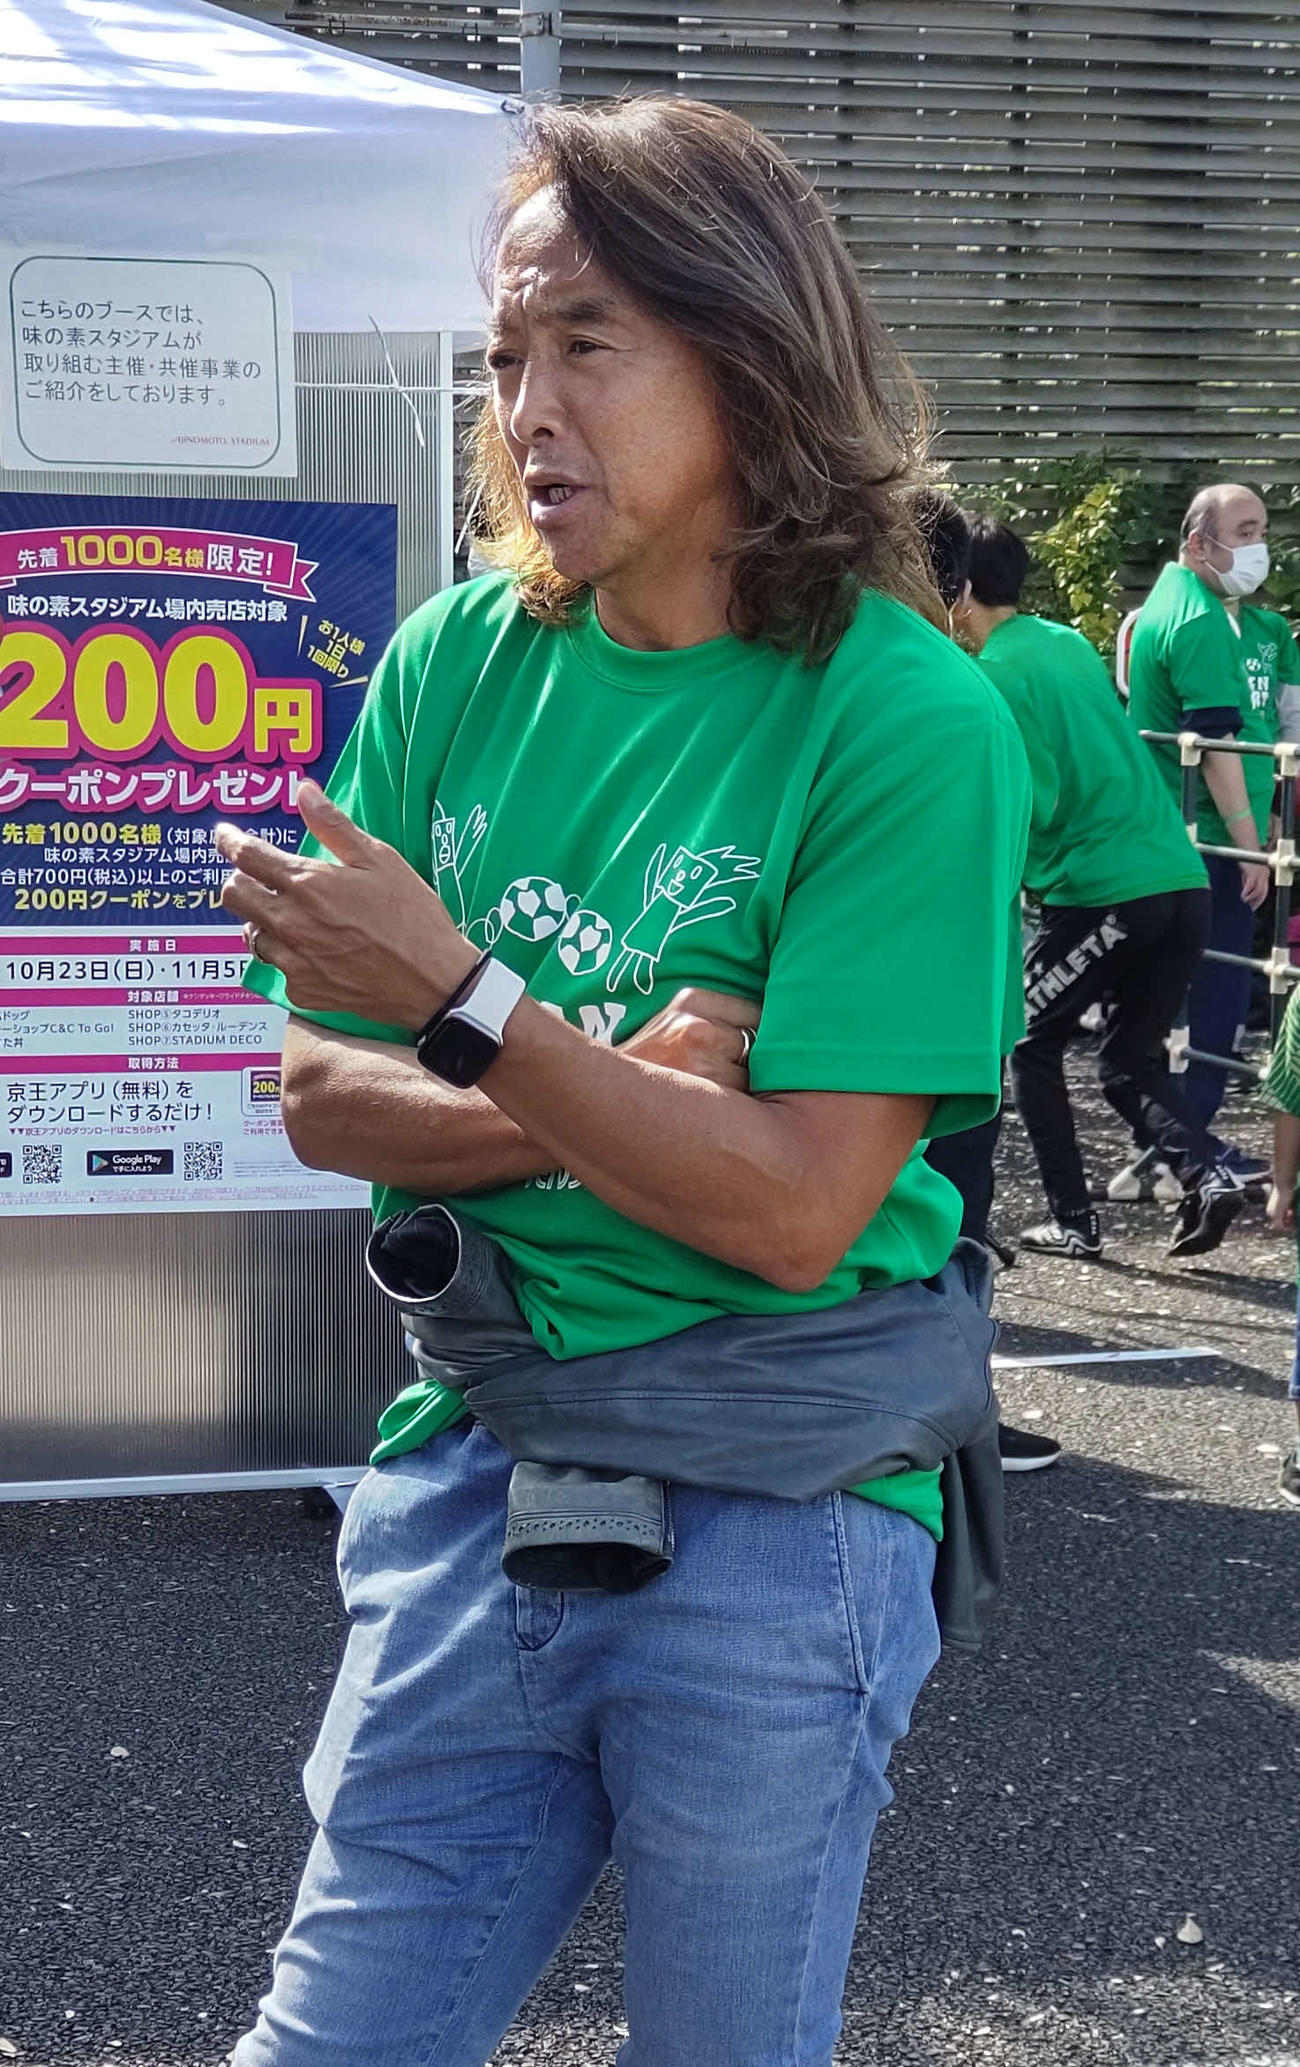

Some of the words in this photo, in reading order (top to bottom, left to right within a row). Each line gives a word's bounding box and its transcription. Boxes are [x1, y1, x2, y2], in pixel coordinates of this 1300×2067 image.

[21, 299, 203, 325] こちらのブースでは、
[22, 326, 202, 351] 味の素スタジアムが
[24, 353, 262, 380] 取り組む主催・共催事業の
[25, 380, 226, 407] ご紹介をしております。
[7, 595, 288, 623] 味の素スタジアム場内売店対象
[307, 644, 349, 678] 1回限り
[44, 847, 233, 864] 味の素スタジアム場内売
[127, 990, 179, 1003] 対象店舗
[0, 1010, 30, 1021] ドッグ
[79, 1023, 91, 1033] To
[95, 1023, 114, 1033] Go!
[230, 1035, 262, 1044] DECO
[128, 1057, 179, 1069] 取得方法
[7, 1103, 213, 1123] ダウンロードするだけ!
[112, 1154, 142, 1166] Google
[144, 1153, 162, 1165] Play
